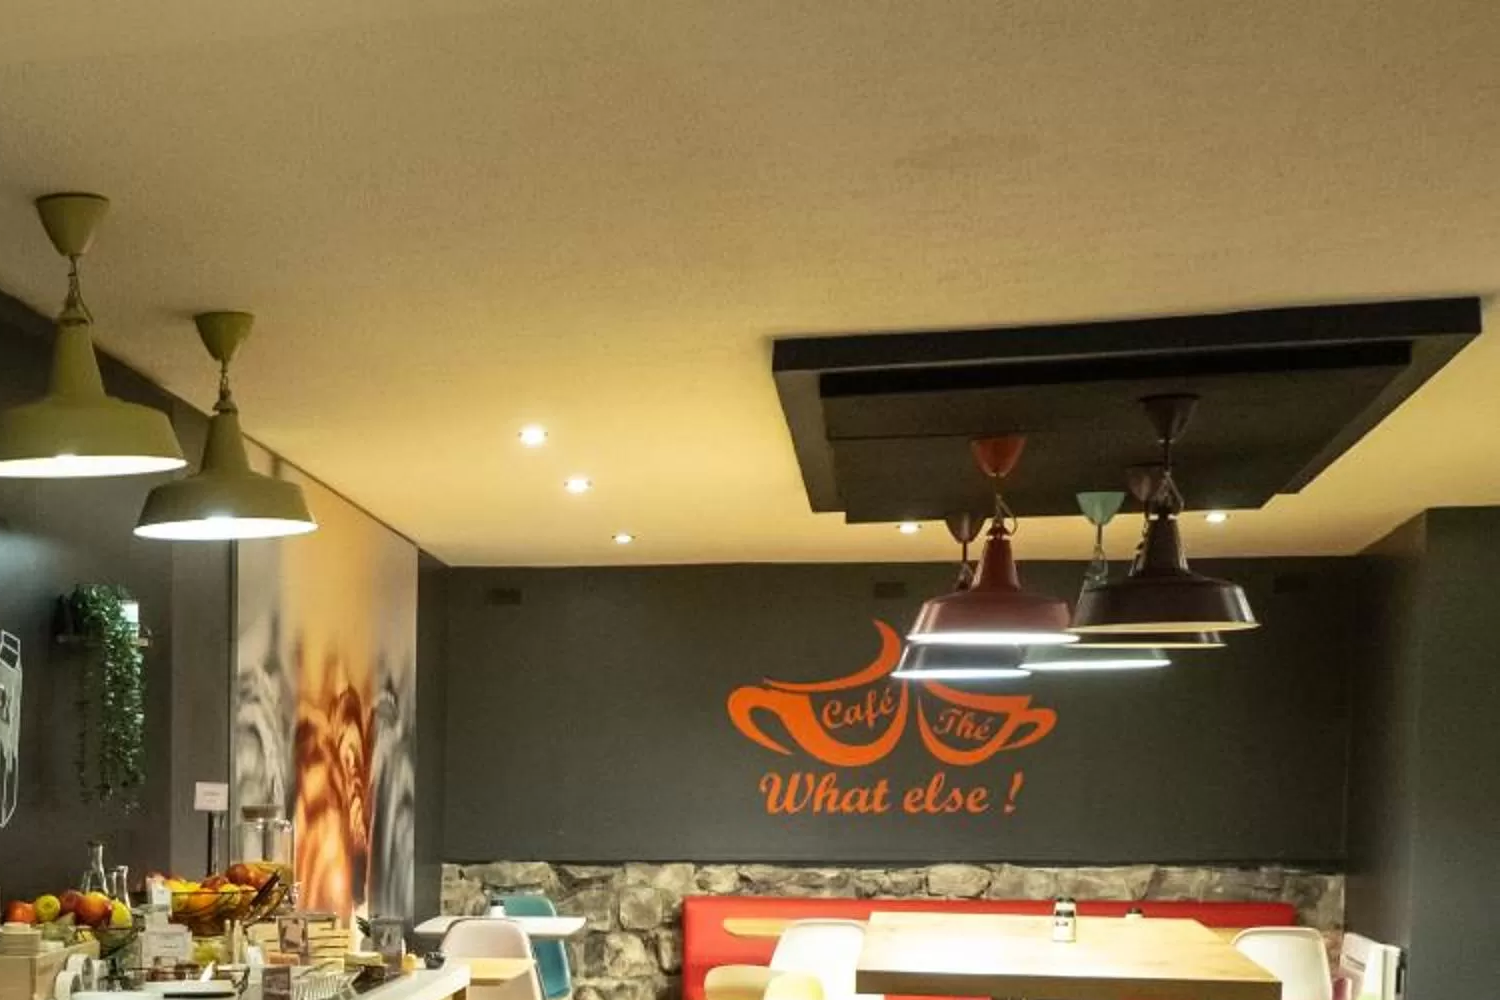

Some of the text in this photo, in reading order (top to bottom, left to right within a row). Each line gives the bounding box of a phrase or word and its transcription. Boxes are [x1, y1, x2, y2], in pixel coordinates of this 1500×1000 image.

[822, 686, 896, 730] Café
[932, 708, 995, 742] Thé
[759, 770, 1024, 816] What else !
